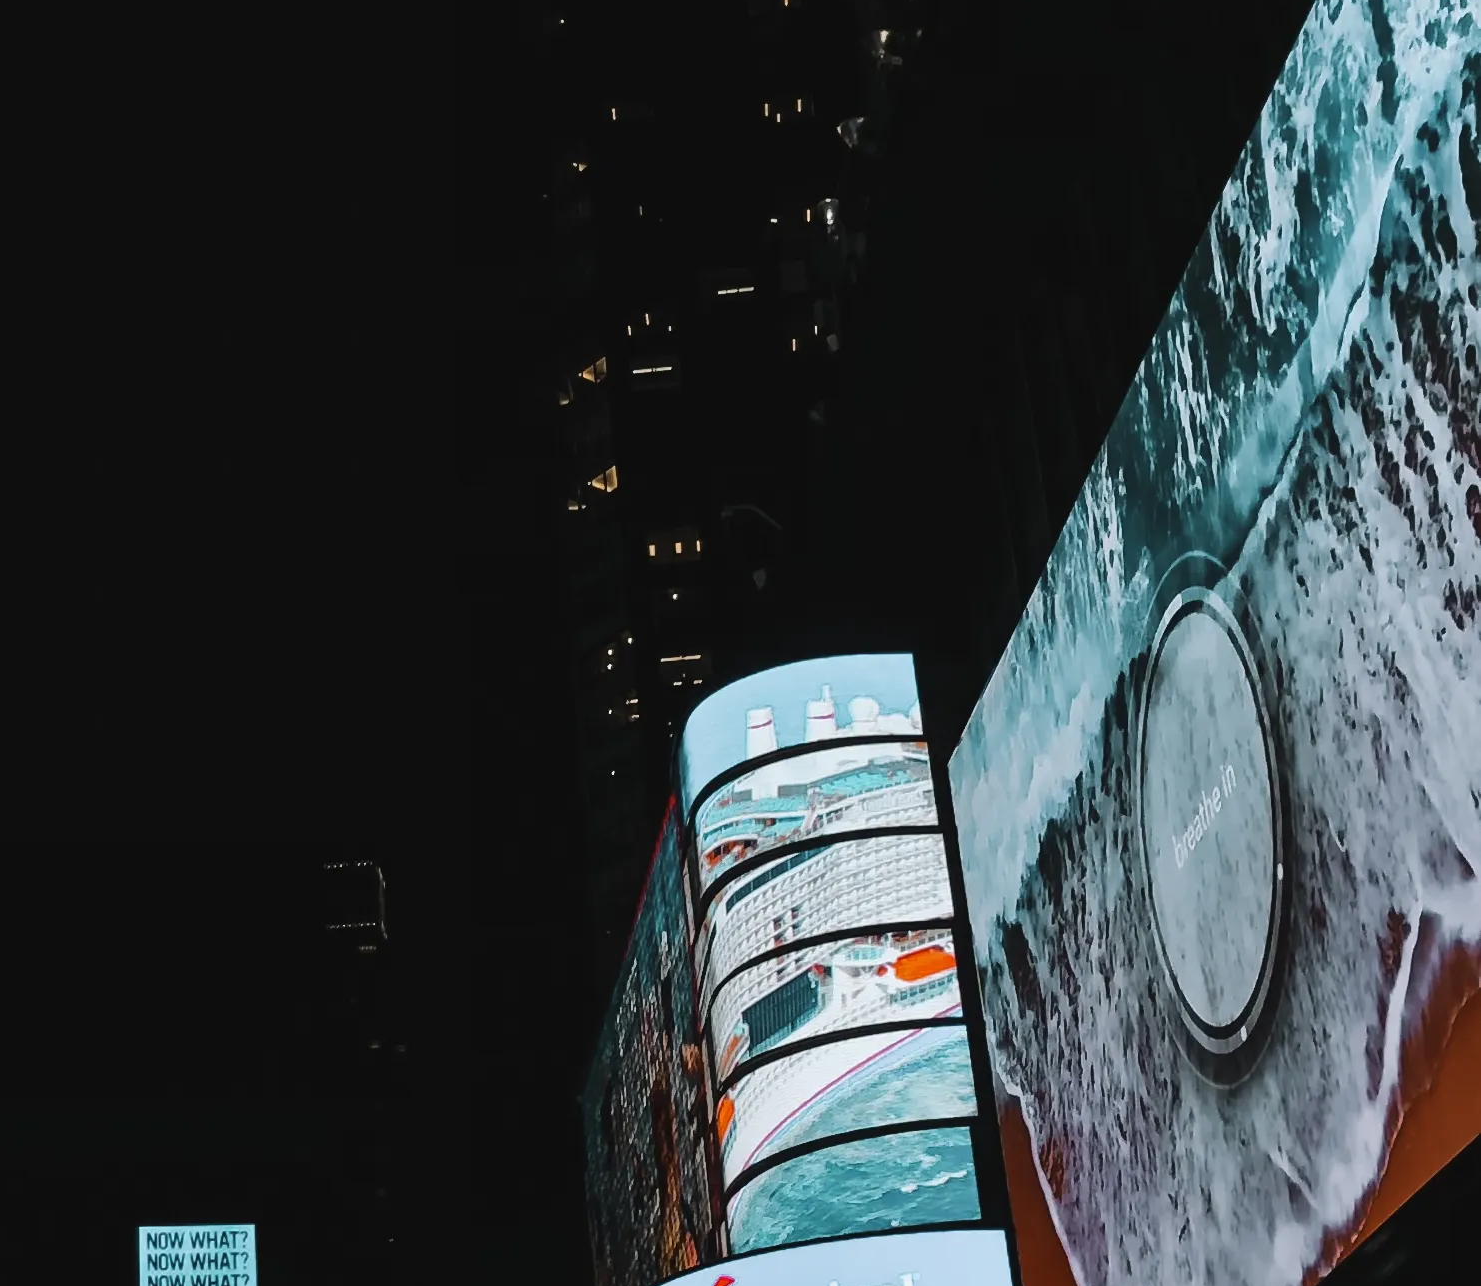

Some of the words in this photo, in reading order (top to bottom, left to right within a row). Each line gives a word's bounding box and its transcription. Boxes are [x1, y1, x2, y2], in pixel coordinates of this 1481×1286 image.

[1171, 785, 1222, 869] breathe
[1220, 764, 1237, 798] in
[146, 1231, 185, 1250] NOW
[190, 1231, 248, 1250] WHAT?
[147, 1252, 185, 1271] NOW
[190, 1252, 249, 1271] WHAT?
